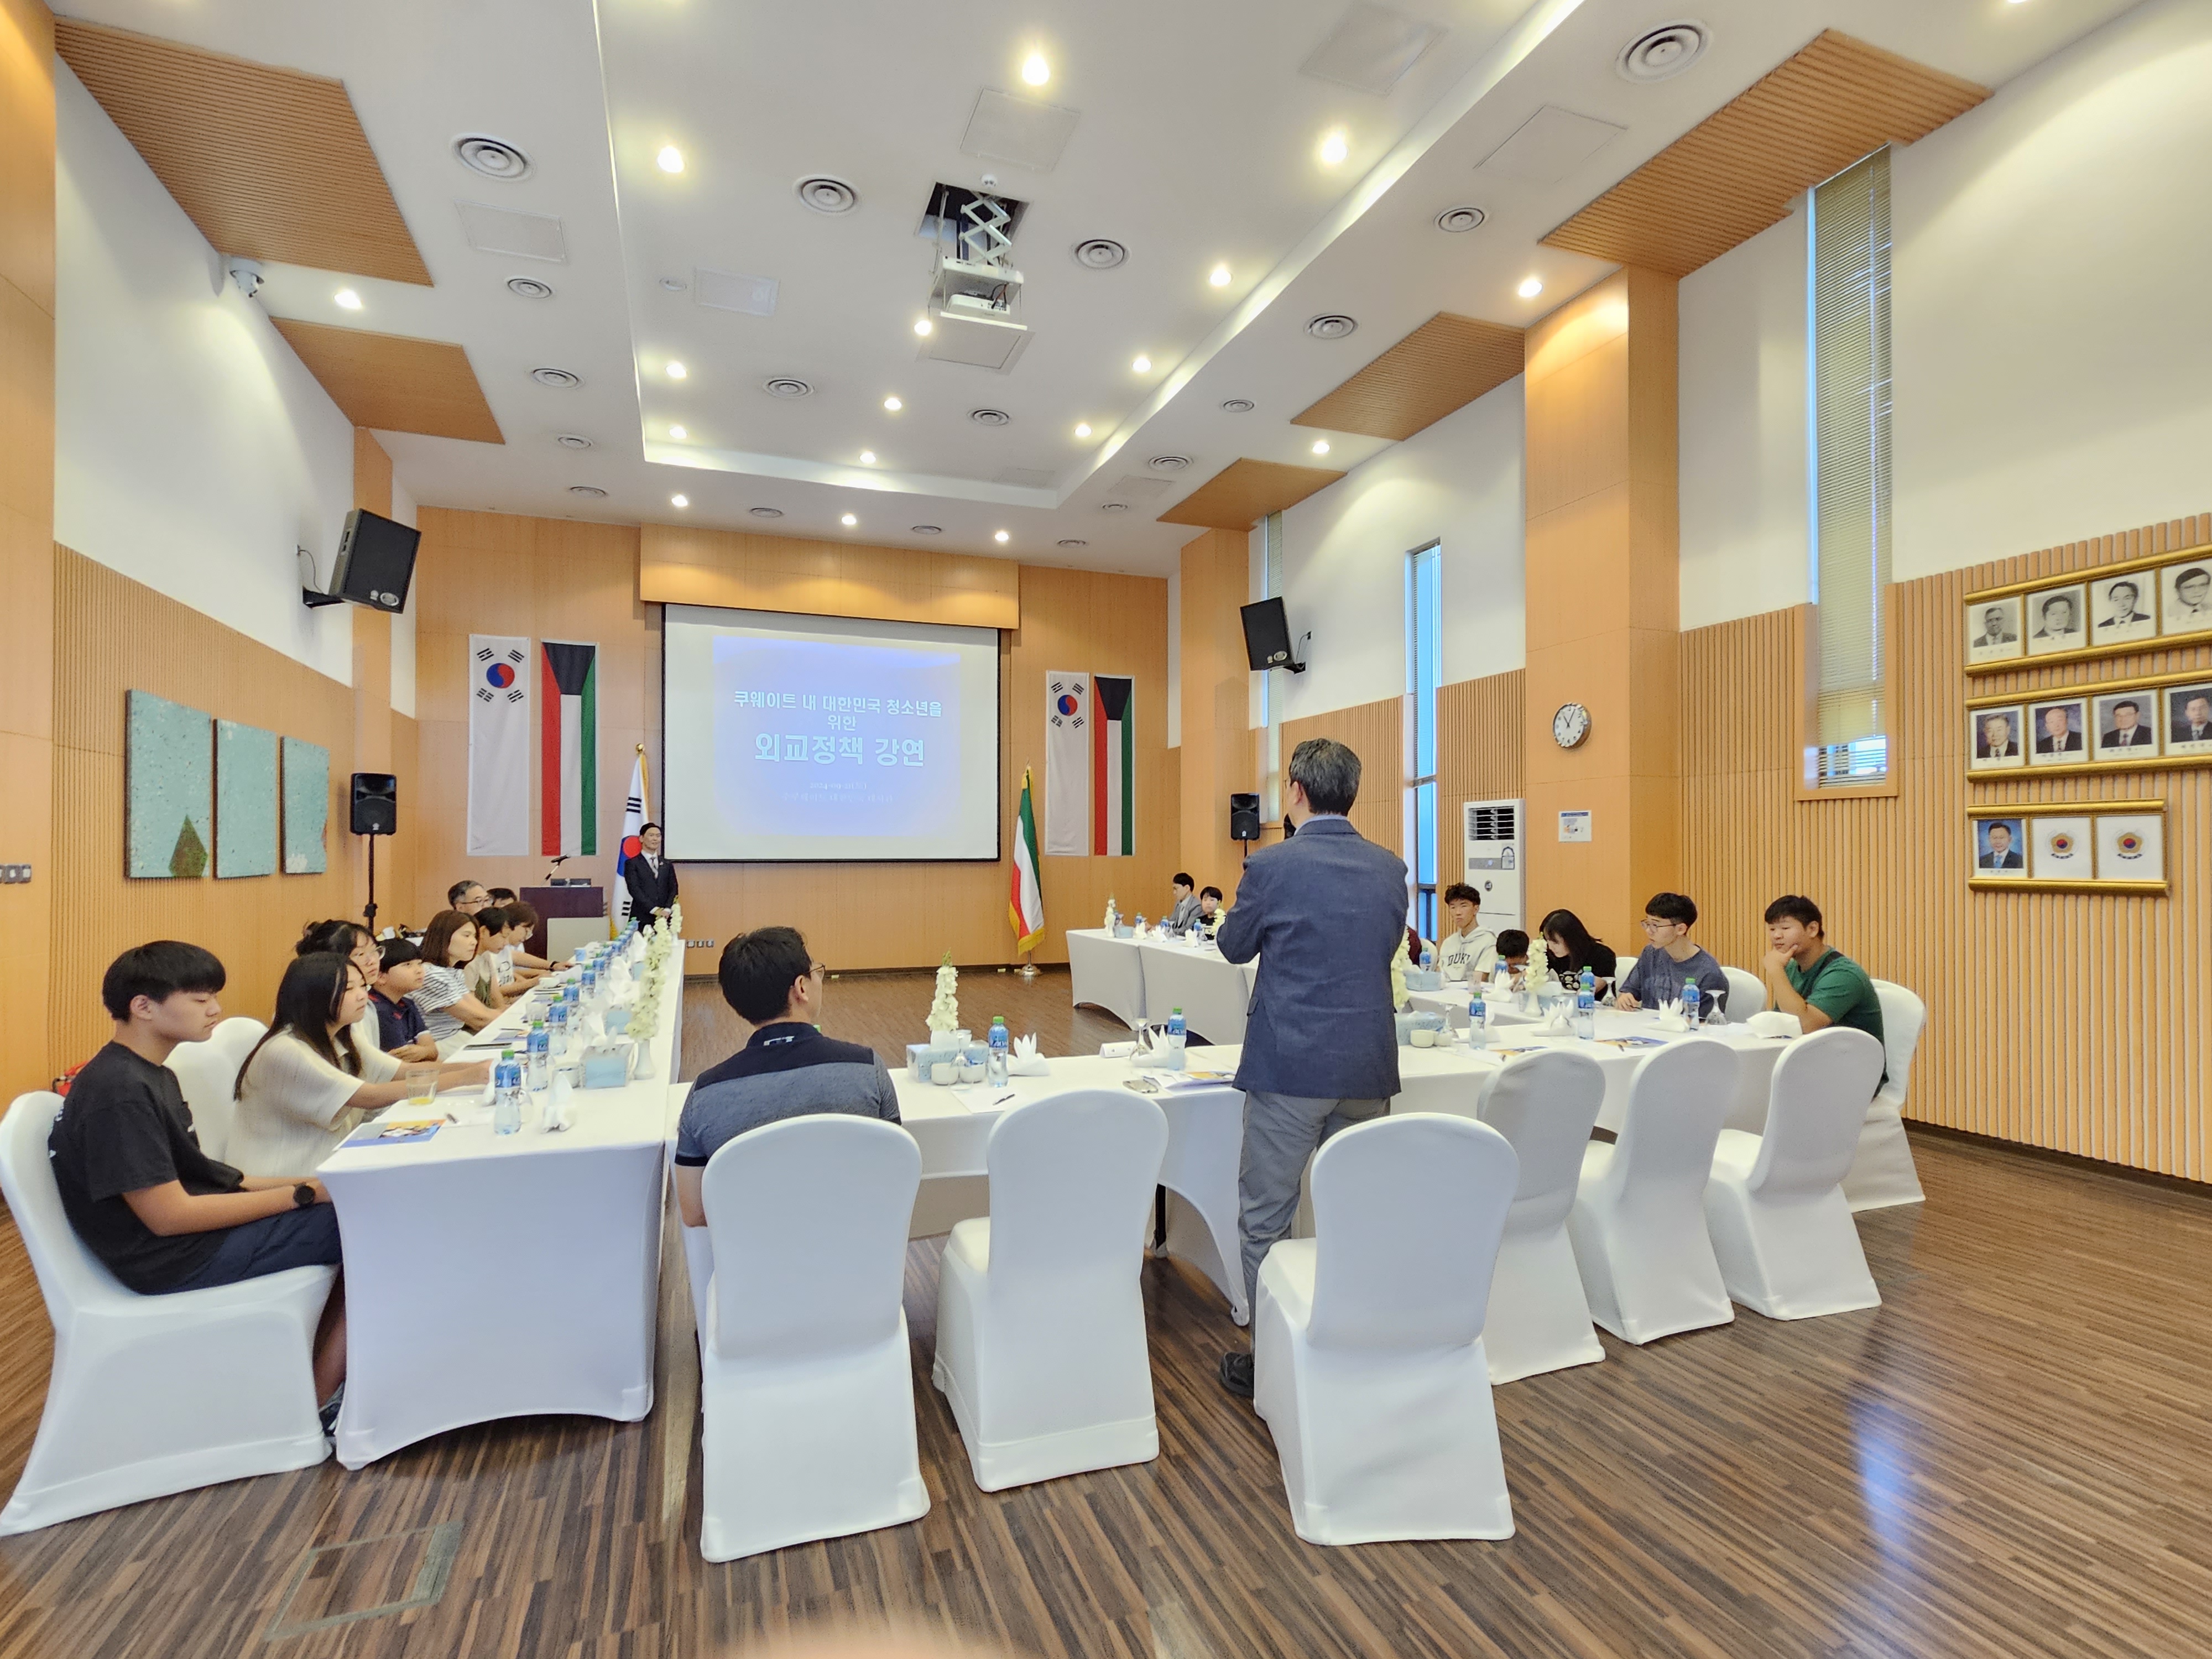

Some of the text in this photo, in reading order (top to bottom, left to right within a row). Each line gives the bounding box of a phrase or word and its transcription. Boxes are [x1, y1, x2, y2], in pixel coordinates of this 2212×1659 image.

[734, 690, 942, 718] 쿠웨이트 내 대한민국 청소년을
[827, 714, 857, 731] 위한
[754, 733, 925, 767] 외교정책 강연
